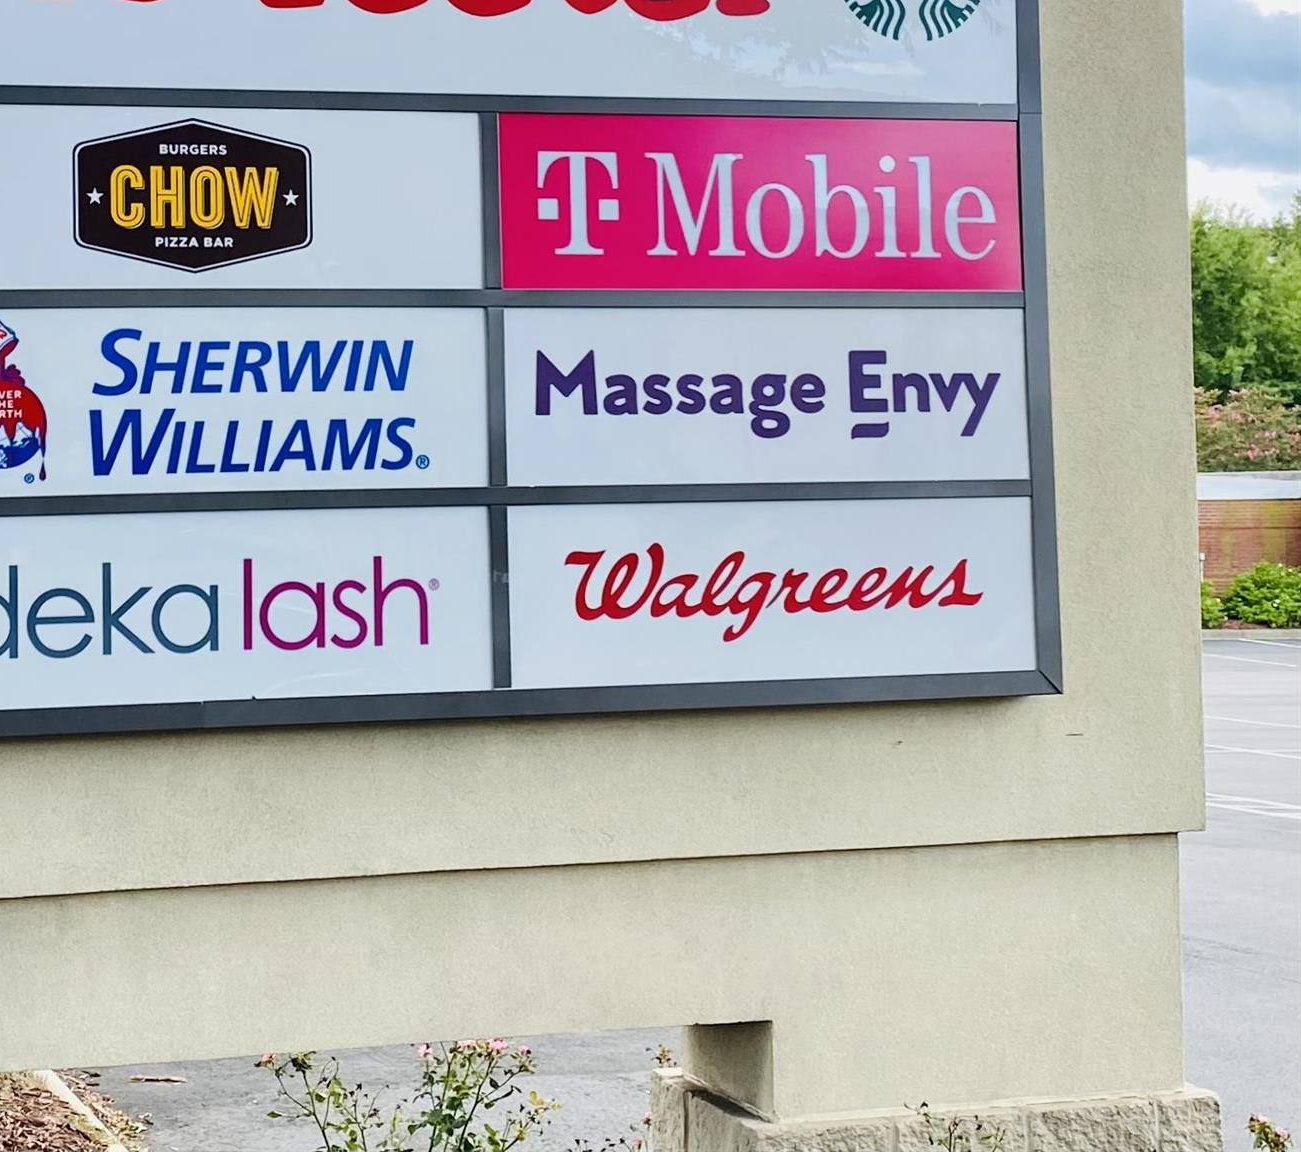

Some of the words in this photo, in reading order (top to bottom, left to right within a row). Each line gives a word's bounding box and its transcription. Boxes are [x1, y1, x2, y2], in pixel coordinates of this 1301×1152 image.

[159, 143, 228, 156] BURGERS
[109, 164, 280, 230] CHOW
[644, 151, 997, 261] Mobile
[155, 236, 200, 248] PIZZA
[203, 237, 234, 248] BAR
[91, 327, 415, 397] SHERWIN
[535, 349, 827, 439] Massage
[847, 349, 1001, 440] Envy
[564, 542, 984, 643] Walgreens
